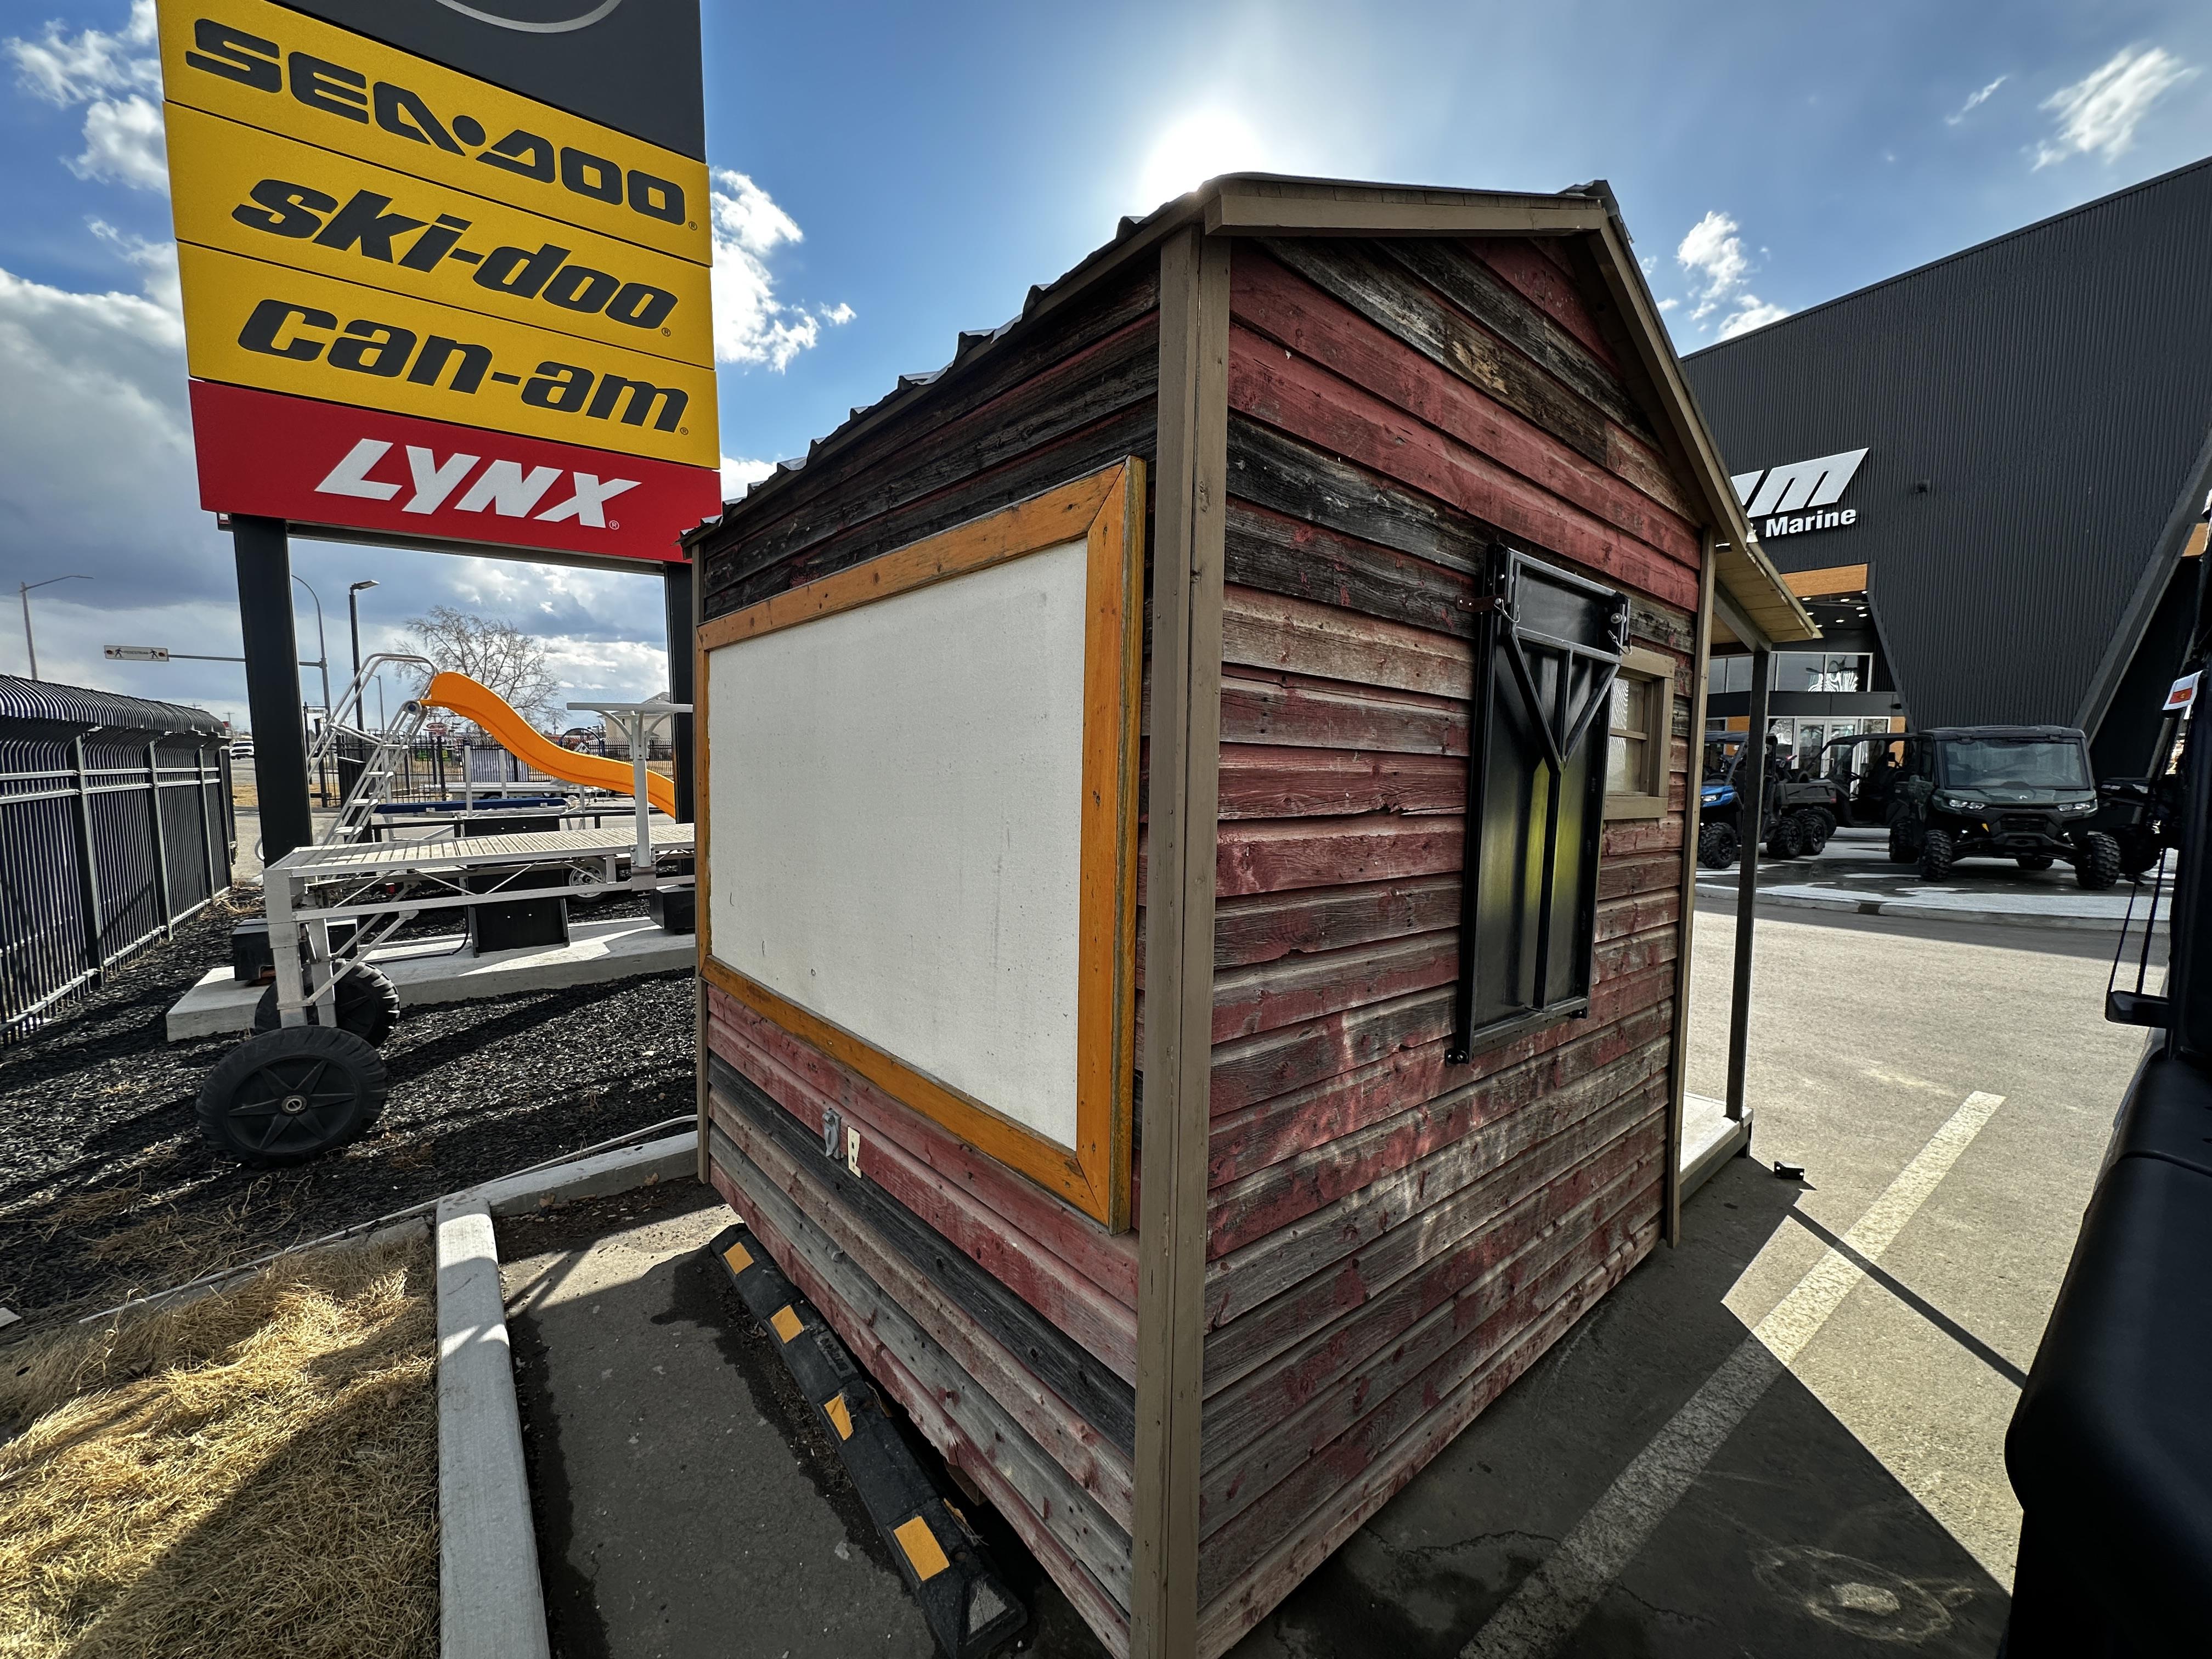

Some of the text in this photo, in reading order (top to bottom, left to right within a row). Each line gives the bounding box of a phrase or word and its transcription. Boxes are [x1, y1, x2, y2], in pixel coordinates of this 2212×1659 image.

[231, 179, 679, 329] ski-doo
[237, 299, 689, 433] can-am
[314, 438, 642, 528] LYNX
[1765, 509, 1857, 538] Marine
